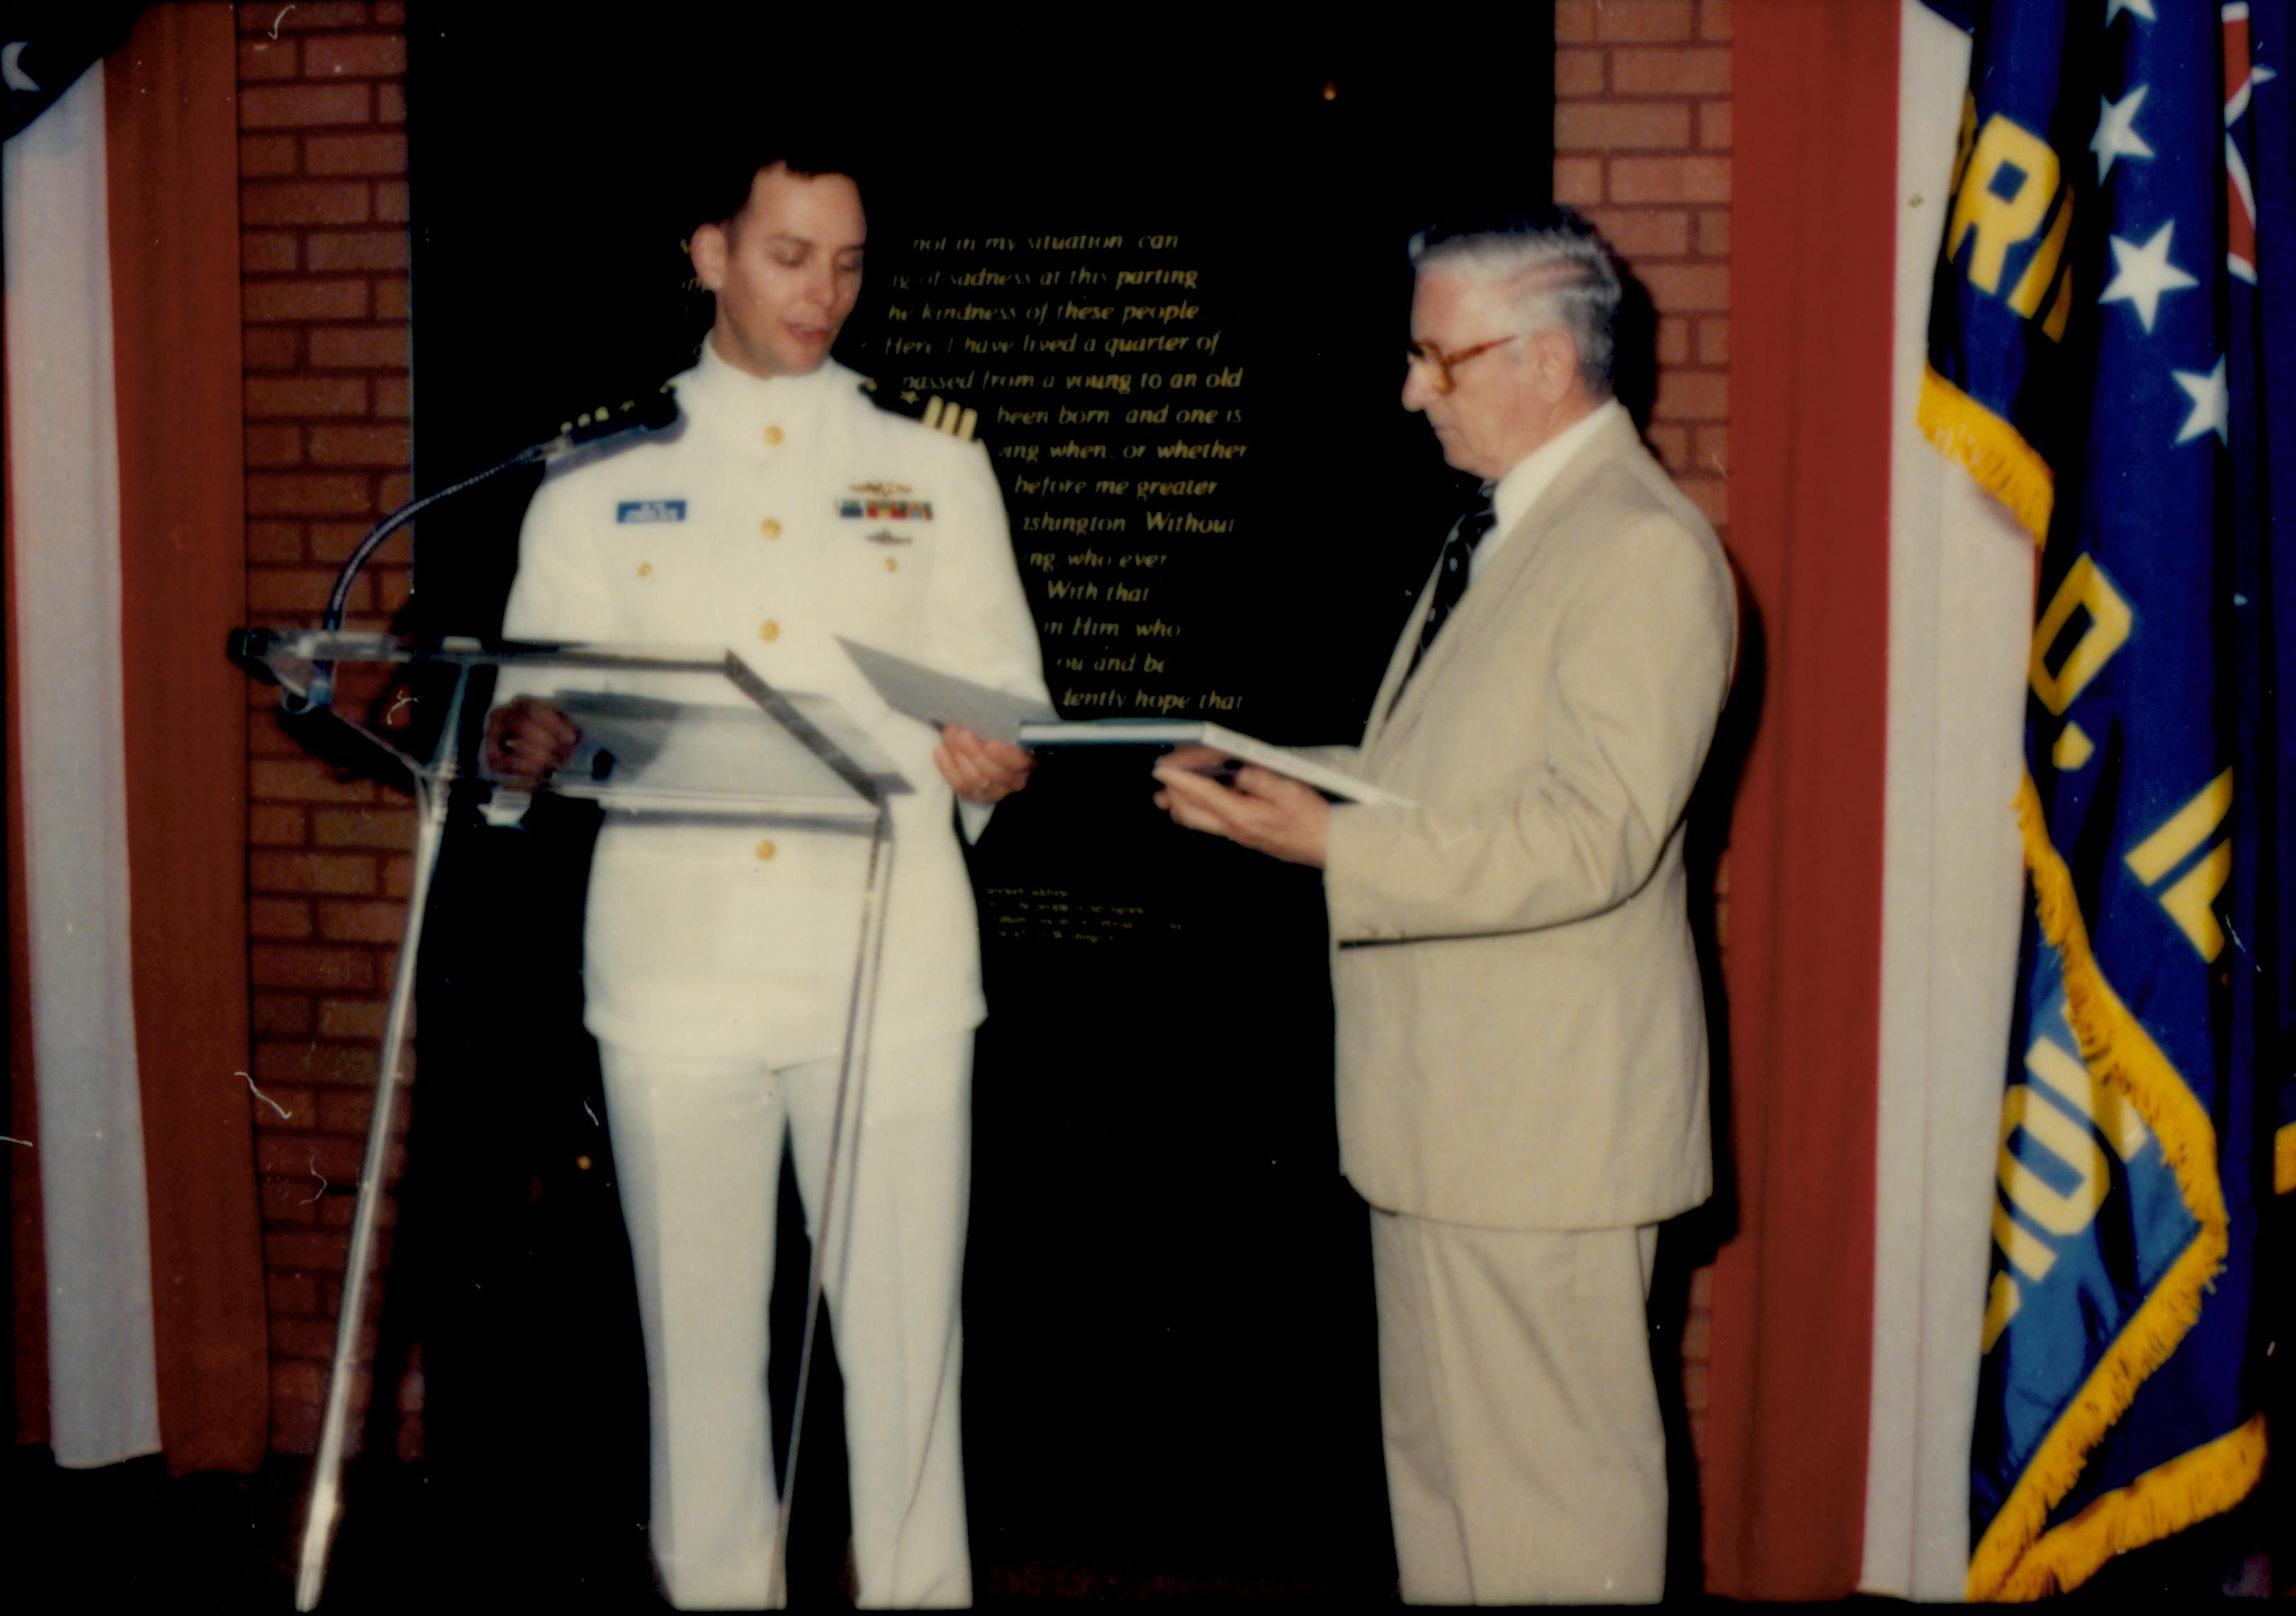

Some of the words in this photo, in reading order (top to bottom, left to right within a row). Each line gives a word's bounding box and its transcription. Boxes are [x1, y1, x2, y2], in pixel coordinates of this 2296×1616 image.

[913, 235, 947, 251] not
[956, 237, 977, 251] in
[985, 237, 1015, 252] my
[1028, 234, 1124, 251] situation
[1137, 234, 1178, 250] can
[951, 266, 1032, 287] sadness
[1040, 269, 1062, 286] at
[1069, 265, 1108, 285] this
[1115, 268, 1198, 291] parting
[921, 302, 1017, 321] kindness
[1025, 302, 1049, 325] of
[1057, 301, 1115, 321] these
[964, 337, 1014, 354] have
[1023, 332, 1079, 353] lived
[1083, 337, 1097, 353] a
[1103, 335, 1191, 359] quarter
[1195, 330, 1222, 357] of
[900, 370, 975, 391] passed
[982, 370, 1035, 389] from
[1042, 374, 1055, 389] a
[1065, 373, 1132, 395] young
[1139, 372, 1163, 390] to
[1169, 372, 1198, 389] an
[1205, 366, 1244, 388] old
[996, 405, 1049, 425] been
[1125, 403, 1170, 425] and
[1175, 408, 1219, 425] one
[1225, 408, 1242, 423] is
[1122, 444, 1148, 459] or
[1157, 438, 1248, 460] whether
[1013, 473, 1087, 497] before
[1095, 479, 1130, 495] me
[1136, 478, 1219, 502] greater
[1145, 510, 1234, 534] Without
[1067, 547, 1113, 568] who
[1118, 553, 1168, 569] ever
[1047, 579, 1099, 602] With
[1105, 581, 1150, 603] that
[1043, 621, 1064, 636] in
[1135, 617, 1181, 638] who
[1055, 656, 1084, 673] ou
[1092, 653, 1137, 673] and
[1143, 651, 1166, 674] be
[1135, 688, 1191, 716] hope
[1198, 688, 1245, 712] that
